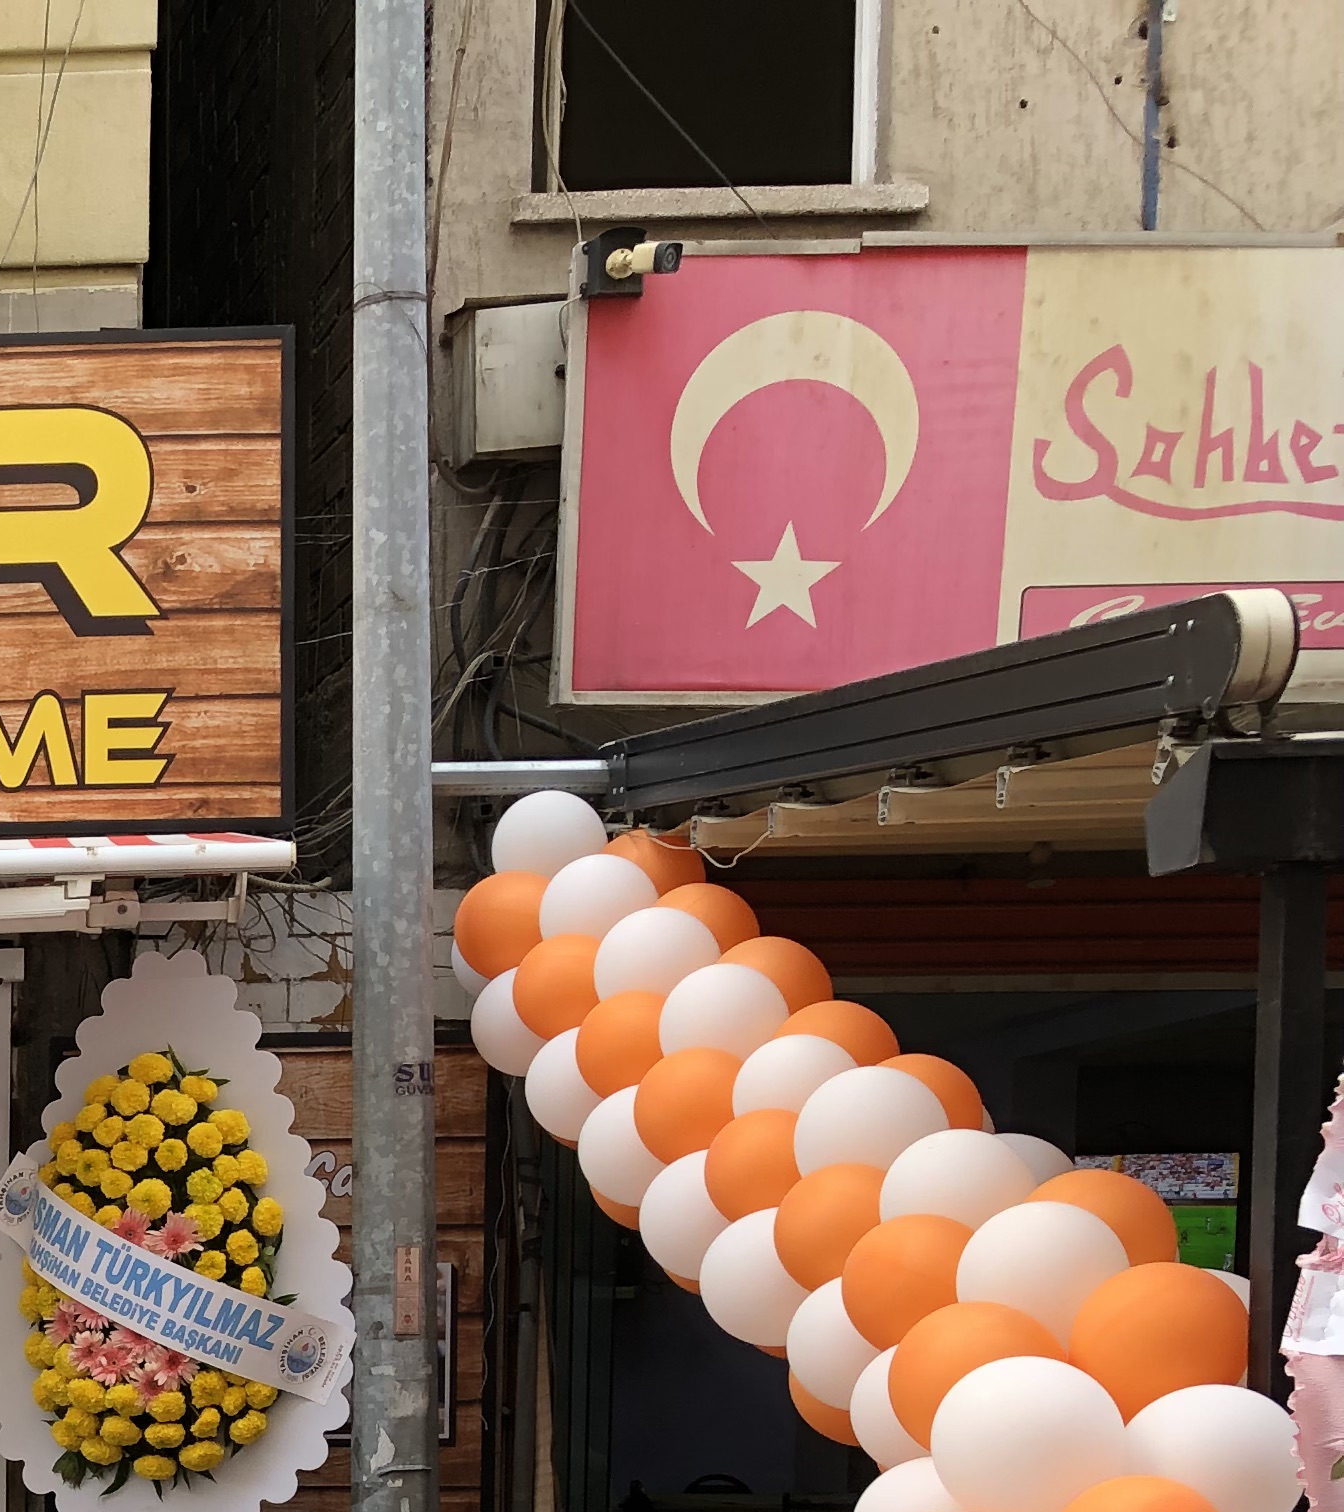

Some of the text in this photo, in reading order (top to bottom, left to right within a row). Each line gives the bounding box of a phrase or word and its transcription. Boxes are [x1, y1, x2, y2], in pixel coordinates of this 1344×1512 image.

[1032, 343, 1344, 521] Sohbe
[91, 1238, 286, 1351] TÜRKYILMAZ
[160, 1318, 244, 1365] BAŞKANI
